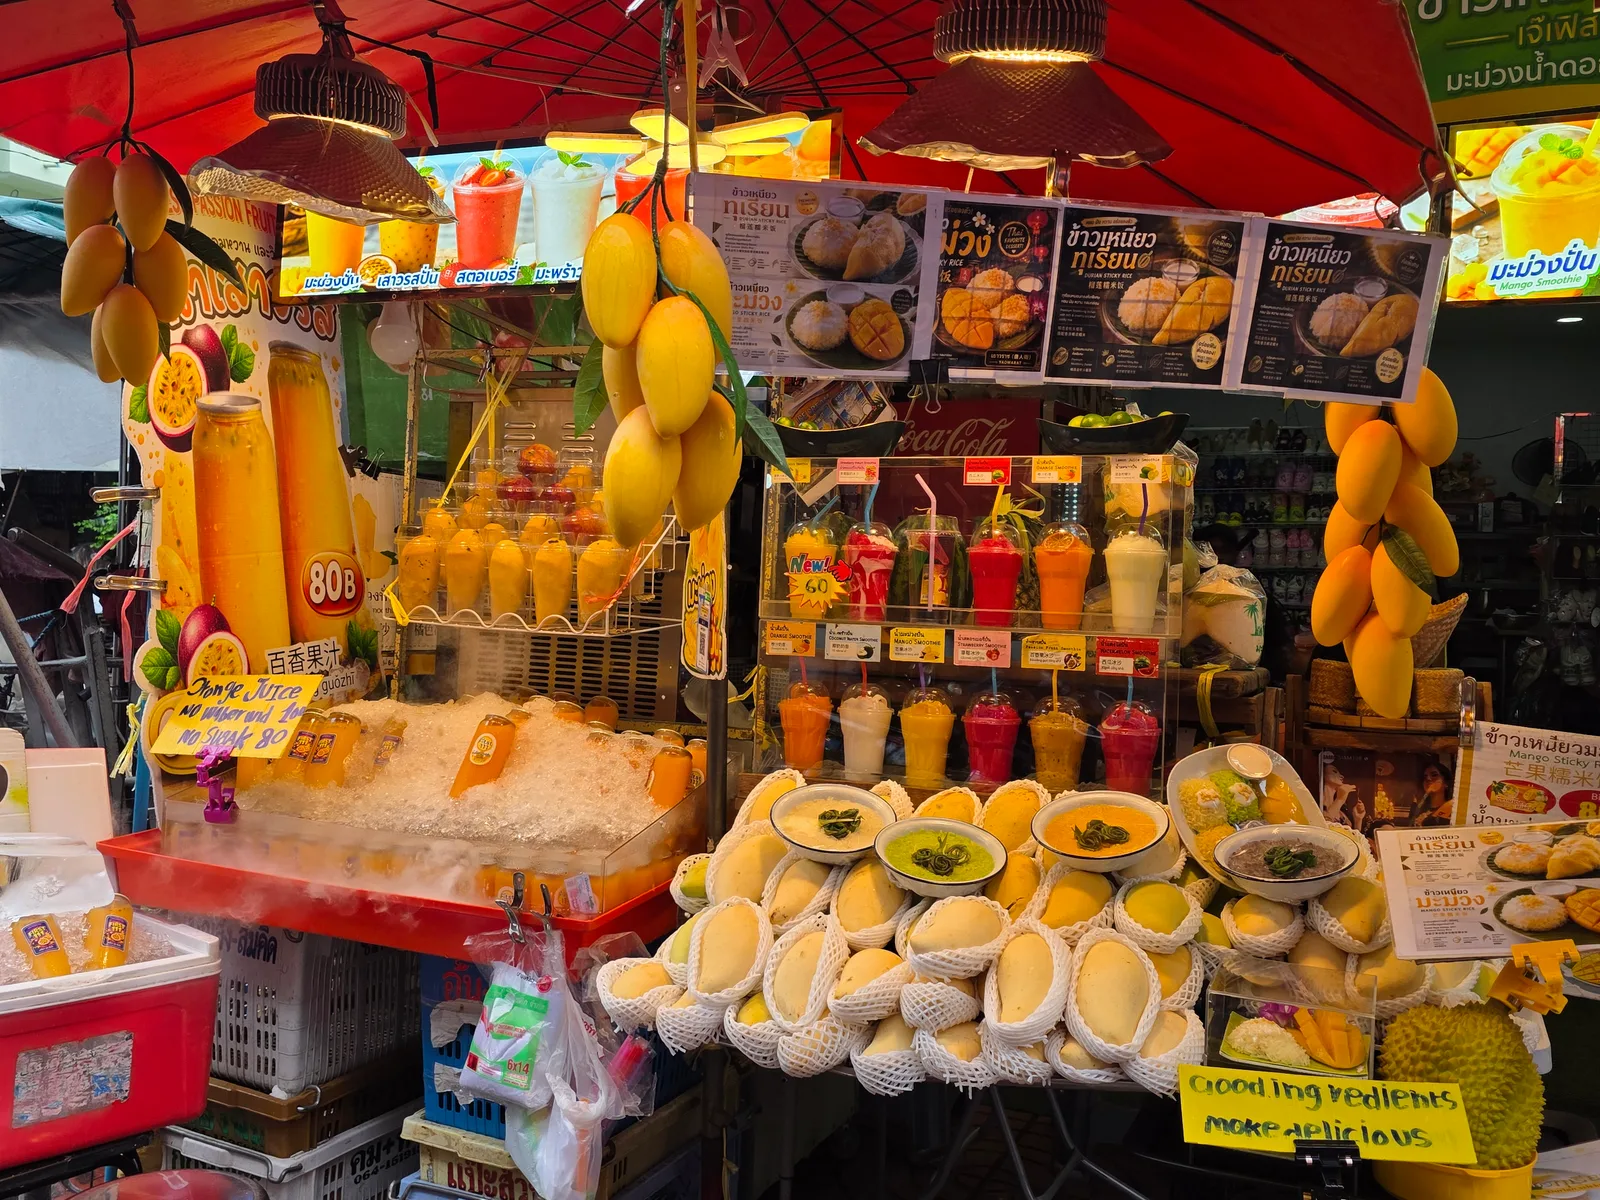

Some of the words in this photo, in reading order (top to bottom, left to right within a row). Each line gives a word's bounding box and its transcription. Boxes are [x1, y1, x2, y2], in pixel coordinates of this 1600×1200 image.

[1447, 51, 1600, 92] มะม่วงน้ำดอ
[732, 186, 777, 199] ข้าวเหนียว
[245, 199, 277, 237] FRUIT
[723, 198, 790, 221] ทุเรียน
[1067, 223, 1157, 248] ข้าวเหนียว
[1071, 246, 1139, 276] ทุเรียน
[1268, 238, 1352, 265] ข้าวเหนียว
[1490, 243, 1597, 281] มะม่วงปั่น
[377, 264, 438, 289] เสาวรสปั่น
[456, 258, 518, 284] สตอเบอรี่
[1270, 262, 1334, 289] ทุเรียน
[1500, 279, 1534, 292] Mango
[1535, 274, 1582, 287] Smoothie
[733, 291, 783, 312] ะม่วง
[790, 553, 832, 574] New!
[805, 578, 828, 593] 60
[914, 638, 941, 646] SMOOTHIE
[268, 642, 342, 676] 百香果汁
[255, 728, 289, 749] 80
[1509, 749, 1550, 764] Mango
[1554, 755, 1590, 769] Sticky
[1503, 760, 1600, 789] 芒果糯米
[1408, 838, 1476, 854] ทุเรียน
[1415, 893, 1486, 909] มะม่วง
[507, 1059, 530, 1075] 6x14
